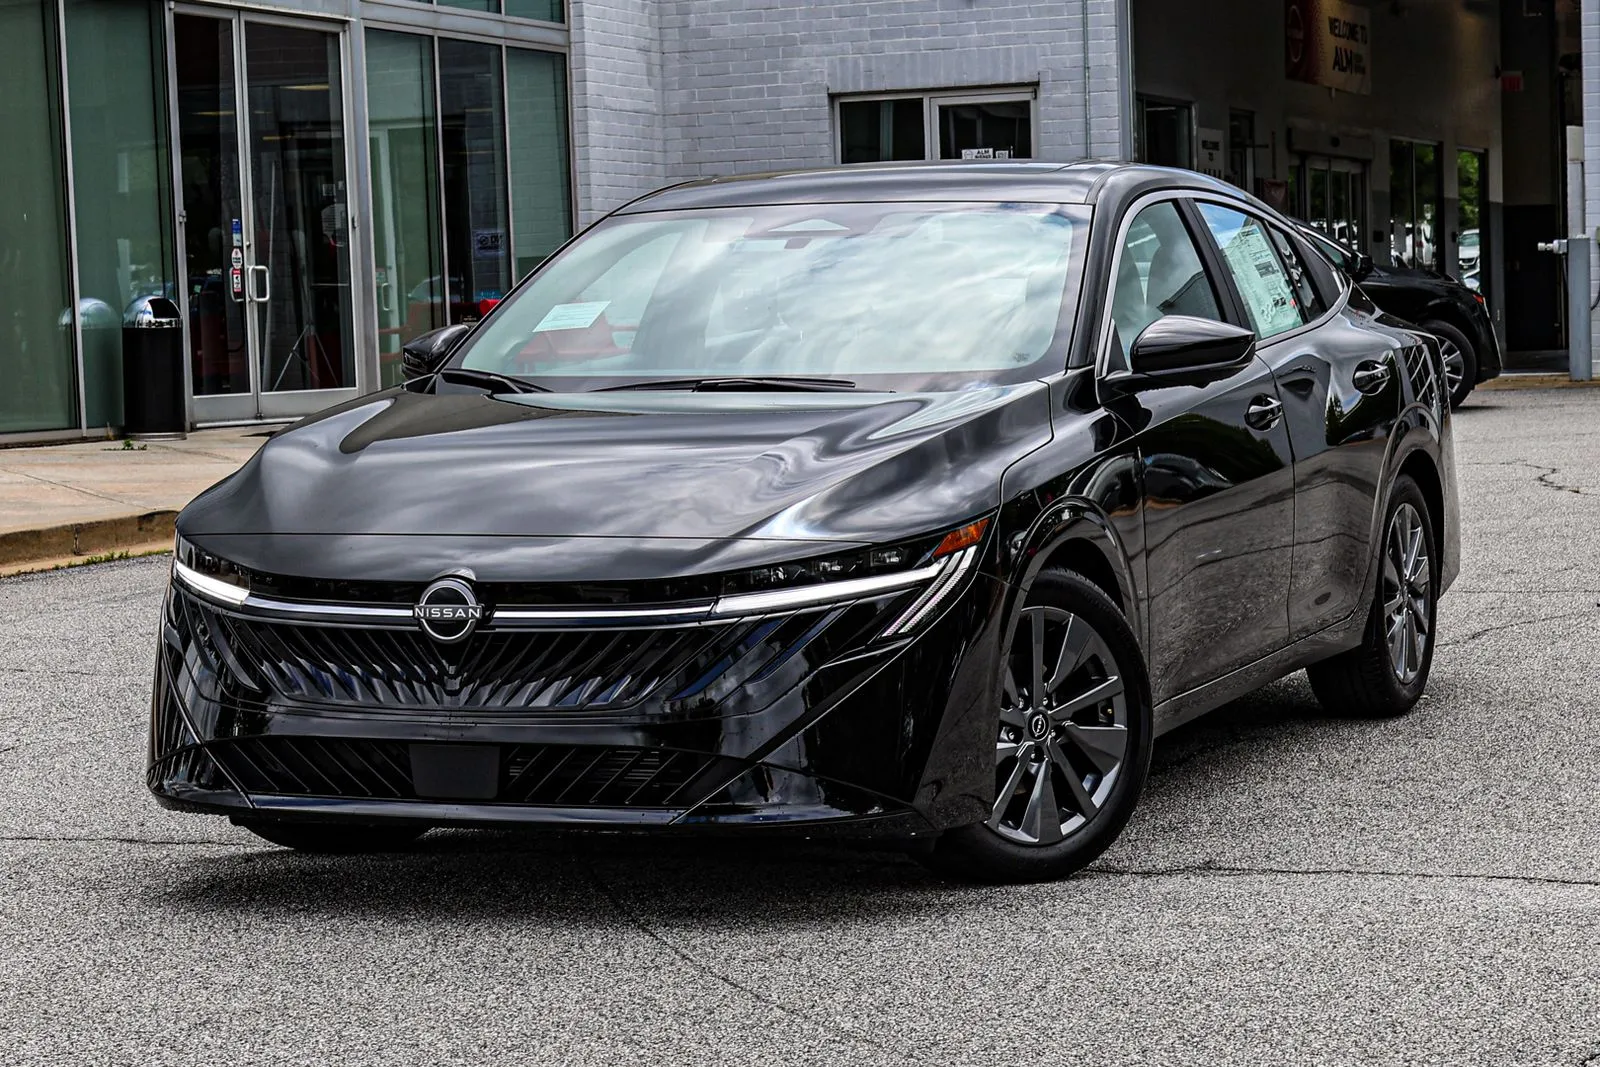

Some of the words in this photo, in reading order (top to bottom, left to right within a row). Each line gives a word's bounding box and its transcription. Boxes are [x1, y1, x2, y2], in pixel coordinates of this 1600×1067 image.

[1327, 16, 1359, 42] WELCOME
[1332, 46, 1353, 75] ALM
[415, 607, 480, 618] NISSAN
